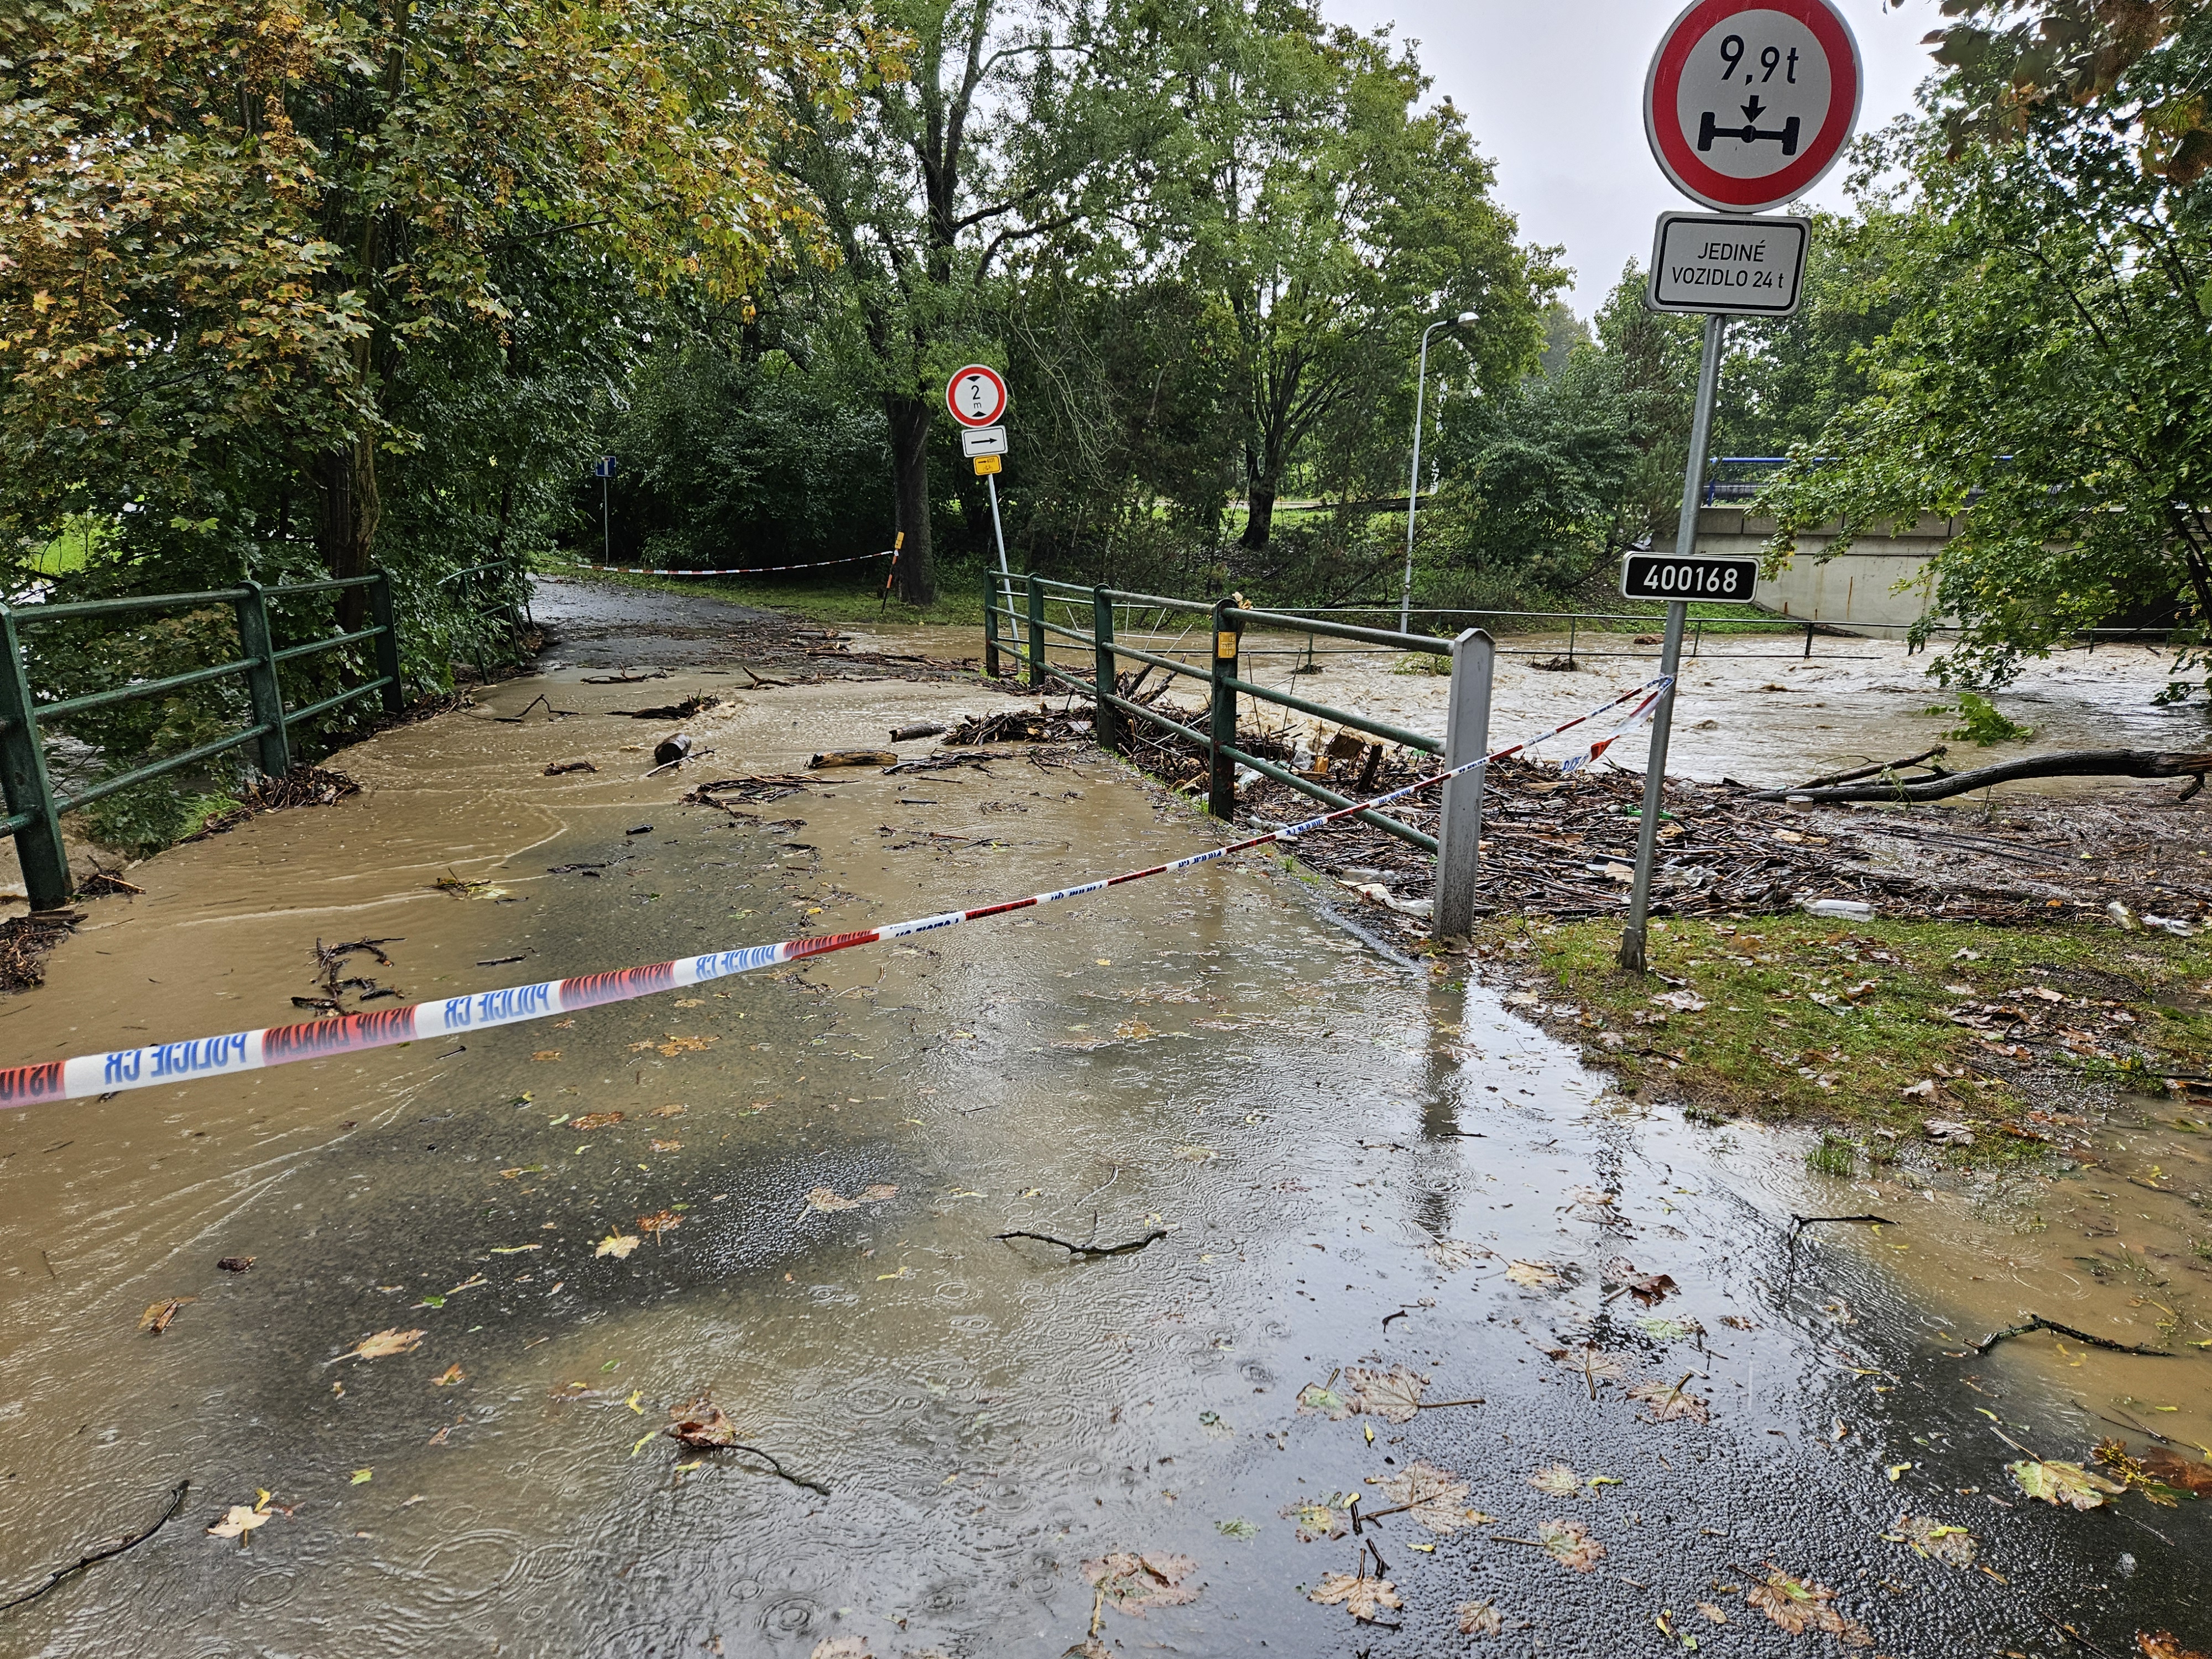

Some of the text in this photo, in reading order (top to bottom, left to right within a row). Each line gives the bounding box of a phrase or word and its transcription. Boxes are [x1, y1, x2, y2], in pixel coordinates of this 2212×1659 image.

[1697, 239, 1766, 262] JEDINÉ
[1672, 267, 1748, 286] VOZIDLO
[1752, 271, 1773, 288] 24
[971, 385, 981, 400] 2
[1644, 565, 1738, 593] 400168
